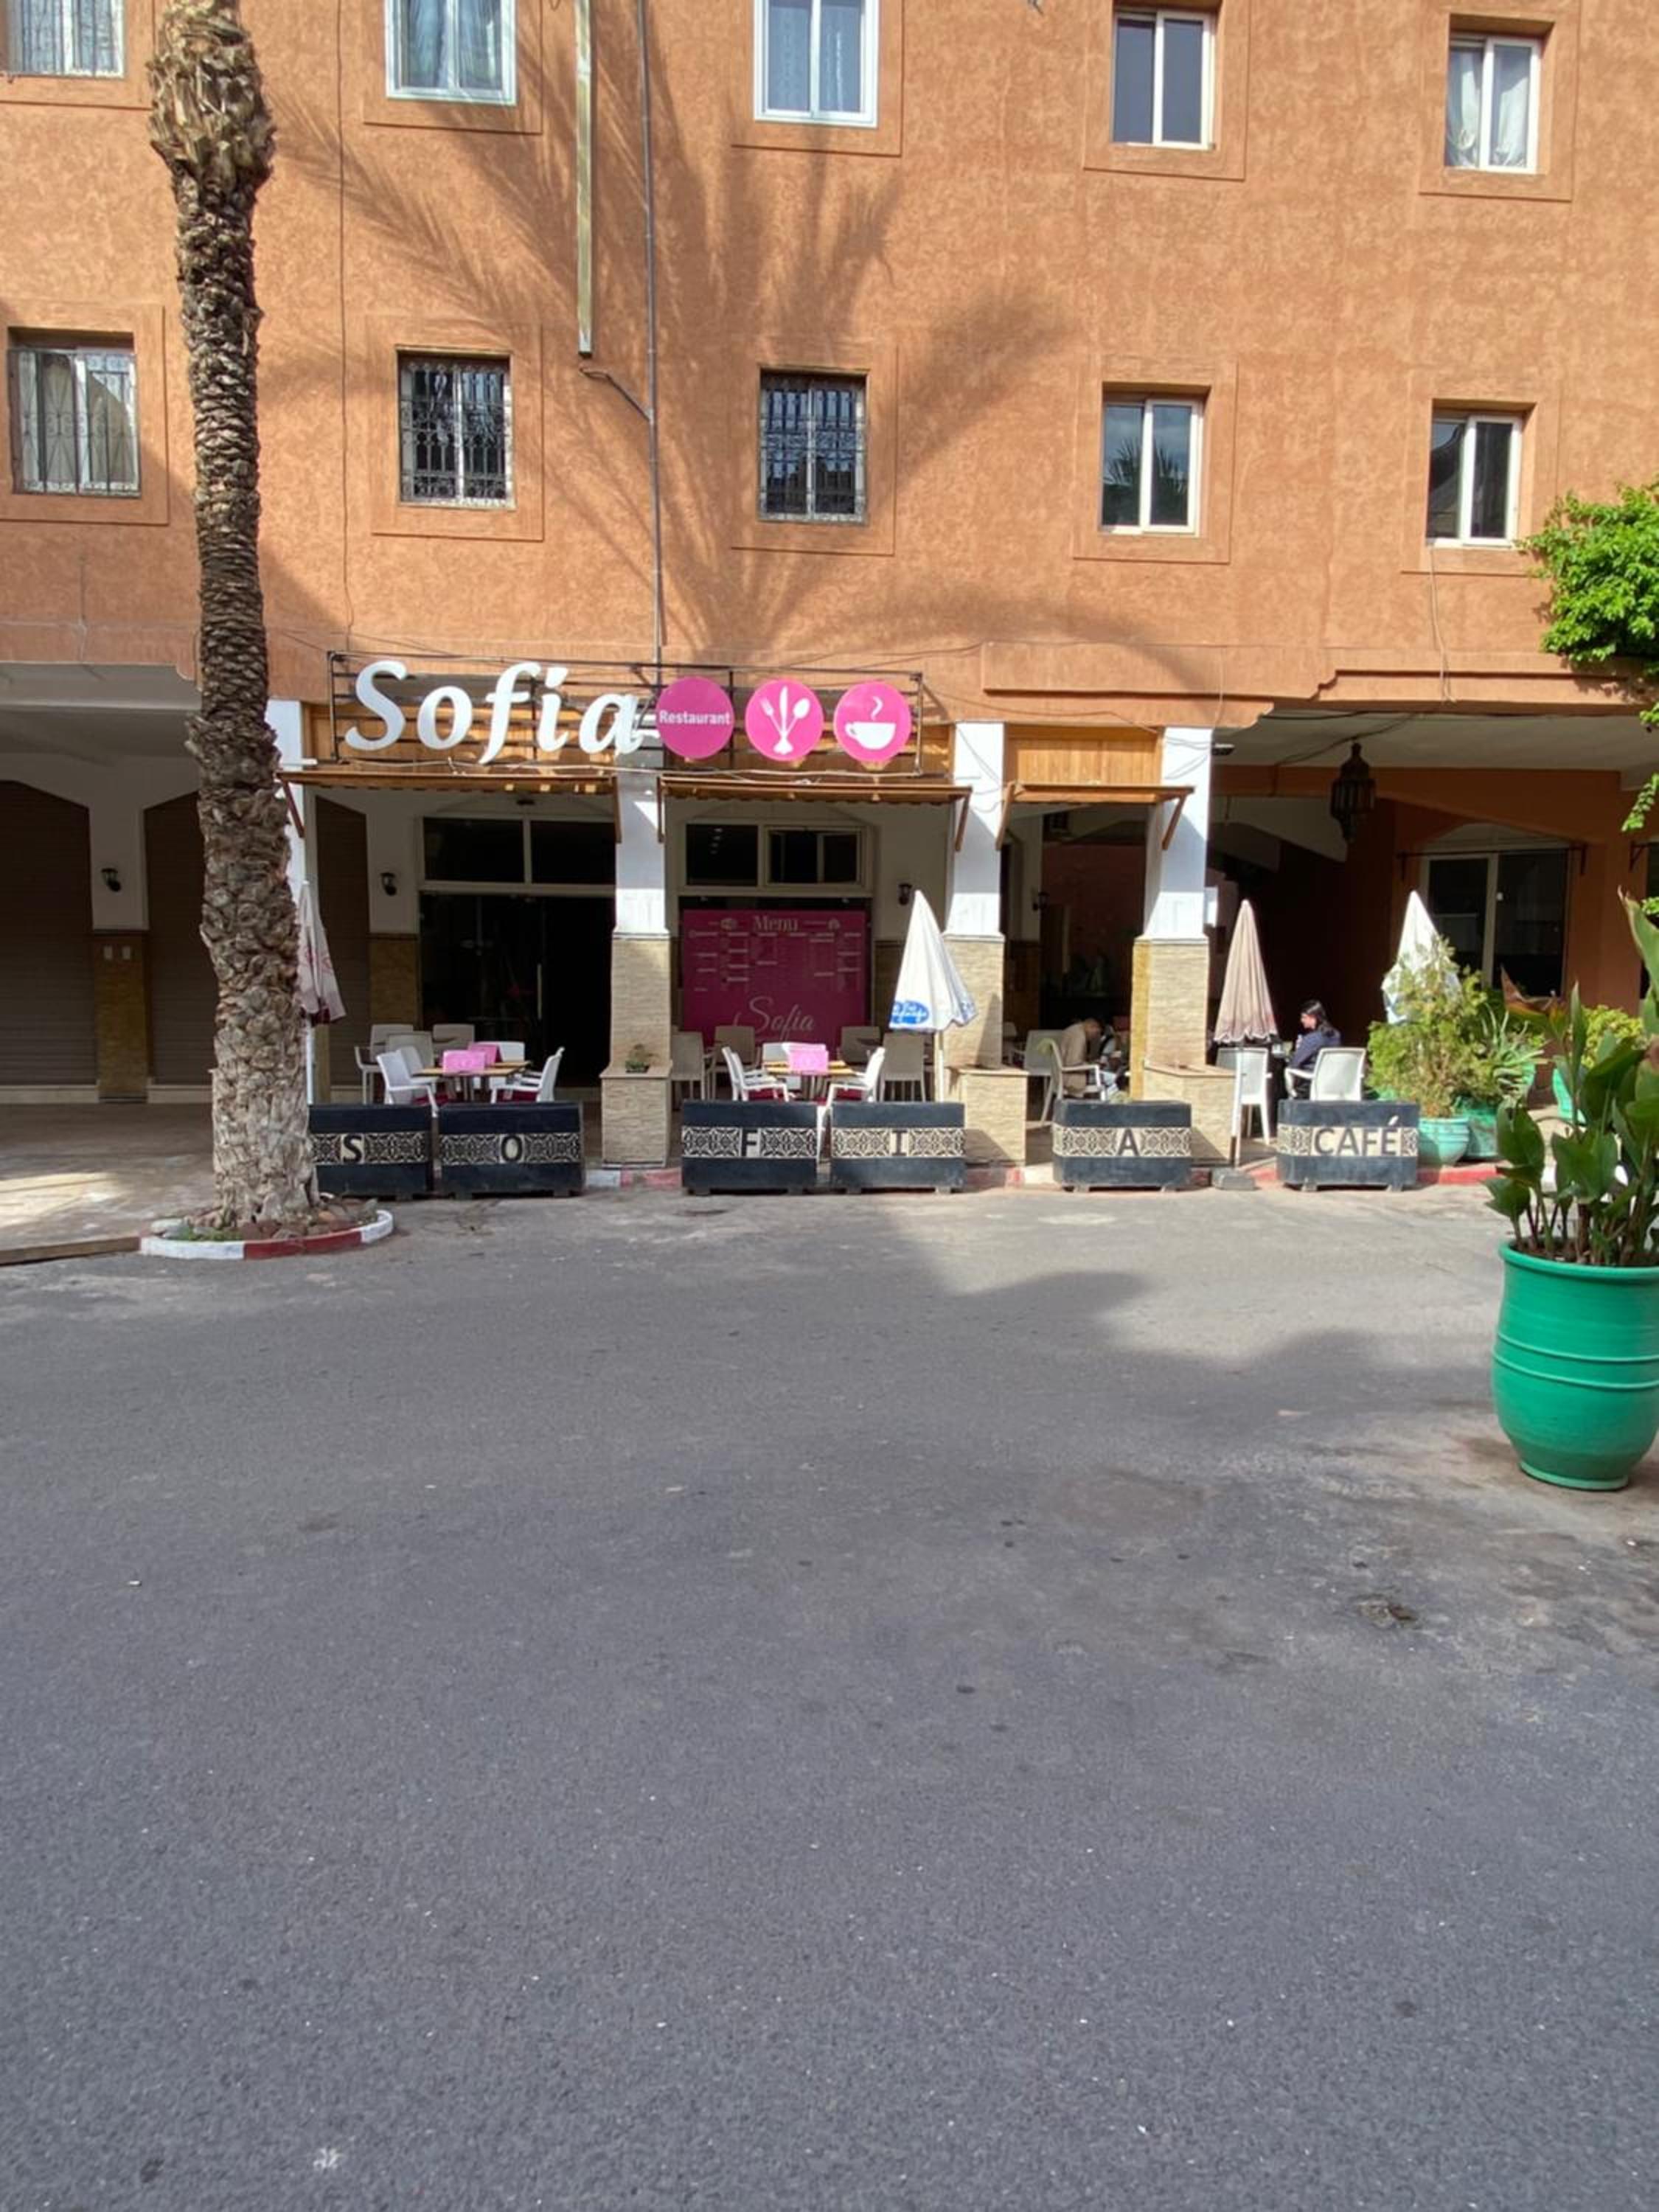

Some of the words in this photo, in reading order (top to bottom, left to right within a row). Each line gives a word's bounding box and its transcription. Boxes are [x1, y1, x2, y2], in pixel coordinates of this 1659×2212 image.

[344, 660, 644, 765] Sofia
[658, 709, 731, 726] Restaurant
[754, 915, 799, 932] Menu
[735, 995, 815, 1041] Sofia
[343, 1134, 363, 1163] S
[501, 1134, 523, 1162] O
[741, 1129, 759, 1156] F
[893, 1130, 906, 1156] I
[1117, 1129, 1140, 1156] A
[1313, 1116, 1398, 1157] CAFÉ
